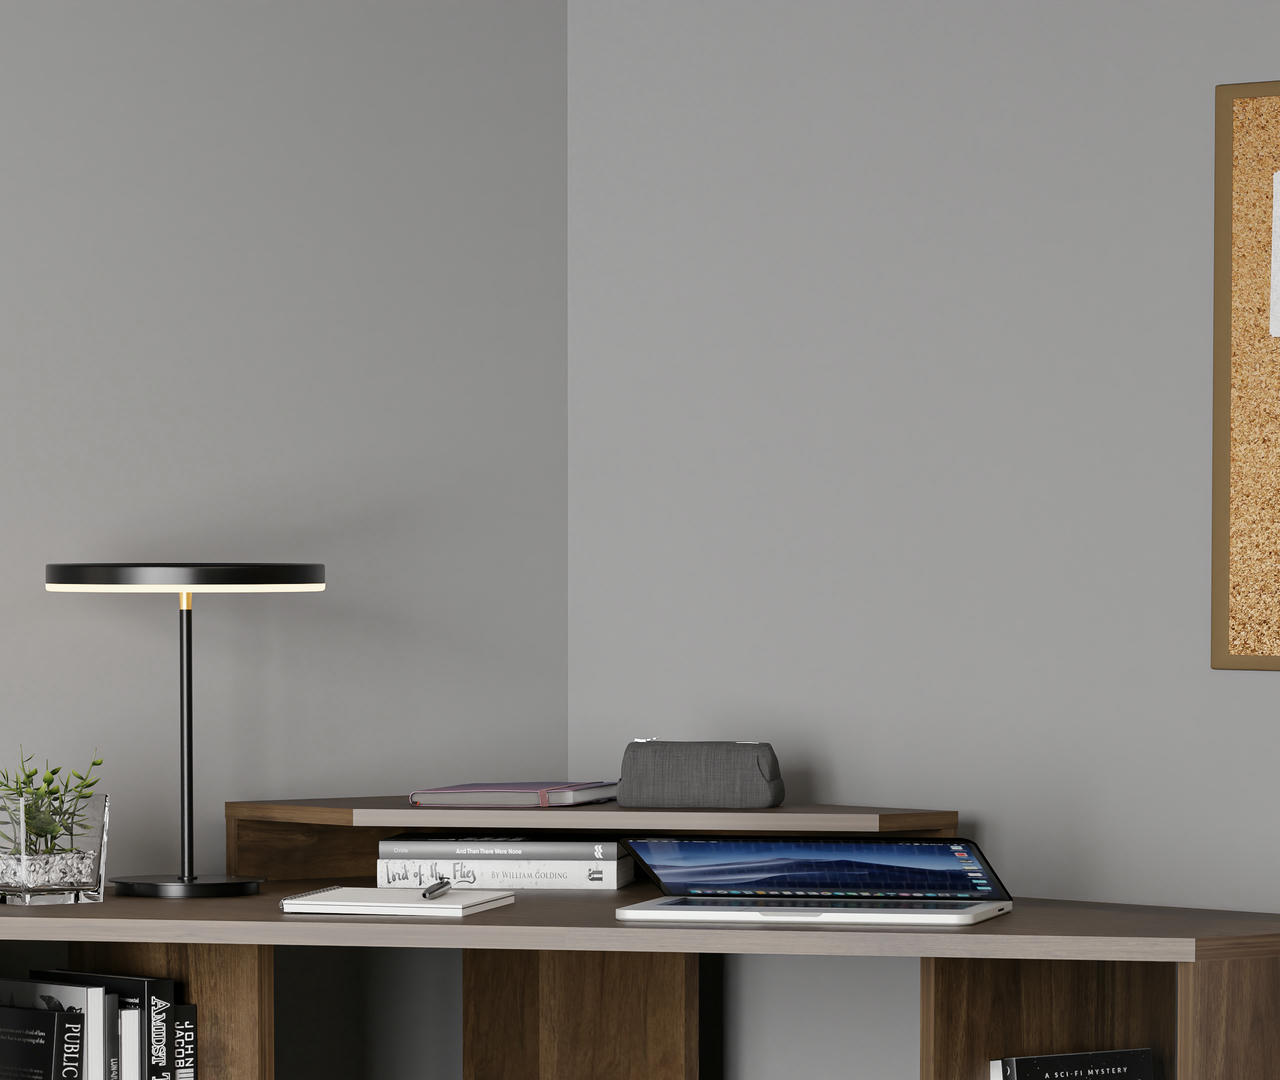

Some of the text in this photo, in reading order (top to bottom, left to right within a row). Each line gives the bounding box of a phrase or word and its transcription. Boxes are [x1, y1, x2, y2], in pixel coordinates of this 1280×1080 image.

[413, 864, 424, 886] of
[453, 862, 476, 884] Flies
[501, 871, 533, 879] WILLIAM
[534, 871, 568, 879] GOLDING
[61, 1023, 81, 1078] PUBLIC
[175, 1021, 185, 1068] JACOB
[184, 1021, 194, 1067] JOHN
[1054, 1070, 1083, 1078] SCI-FI
[1087, 1067, 1128, 1075] MYSTERY
